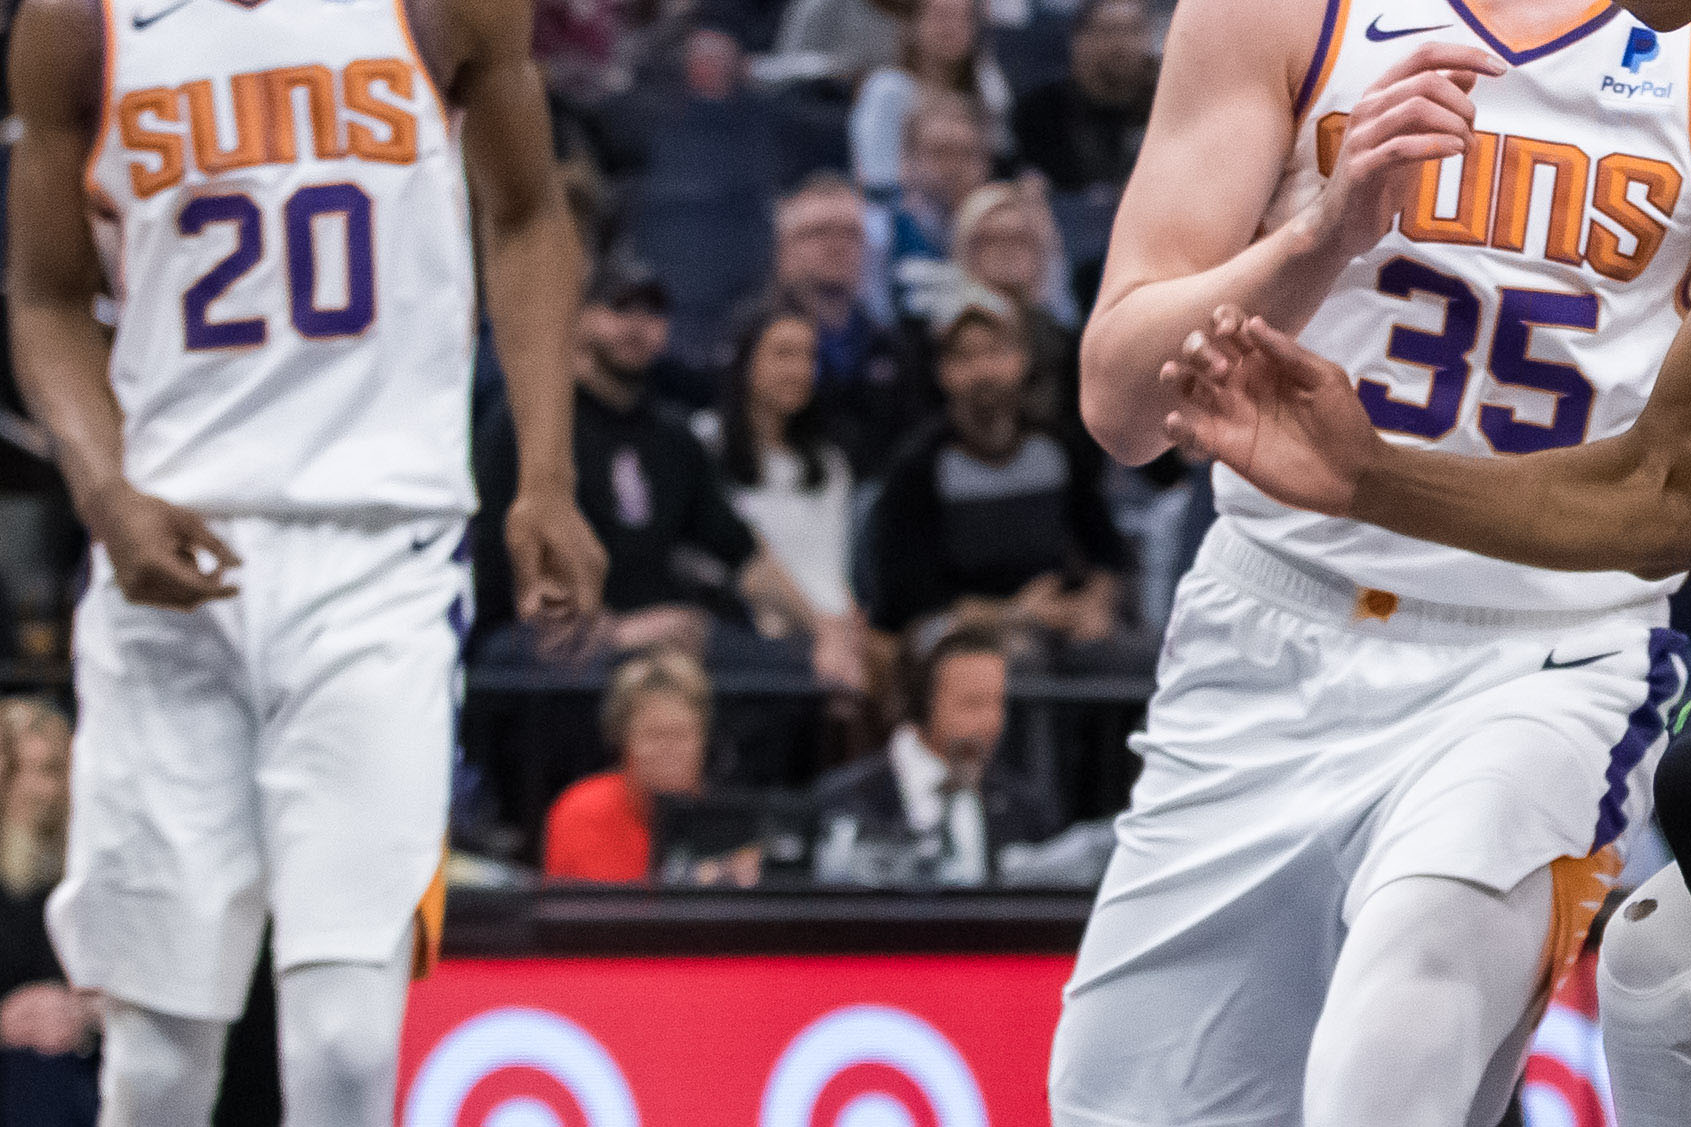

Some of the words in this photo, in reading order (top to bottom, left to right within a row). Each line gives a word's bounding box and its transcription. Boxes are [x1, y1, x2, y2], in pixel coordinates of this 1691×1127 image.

[118, 57, 418, 200] SUNS
[1601, 75, 1673, 99] PayPal
[178, 183, 375, 351] 20
[1357, 256, 1602, 455] 35
